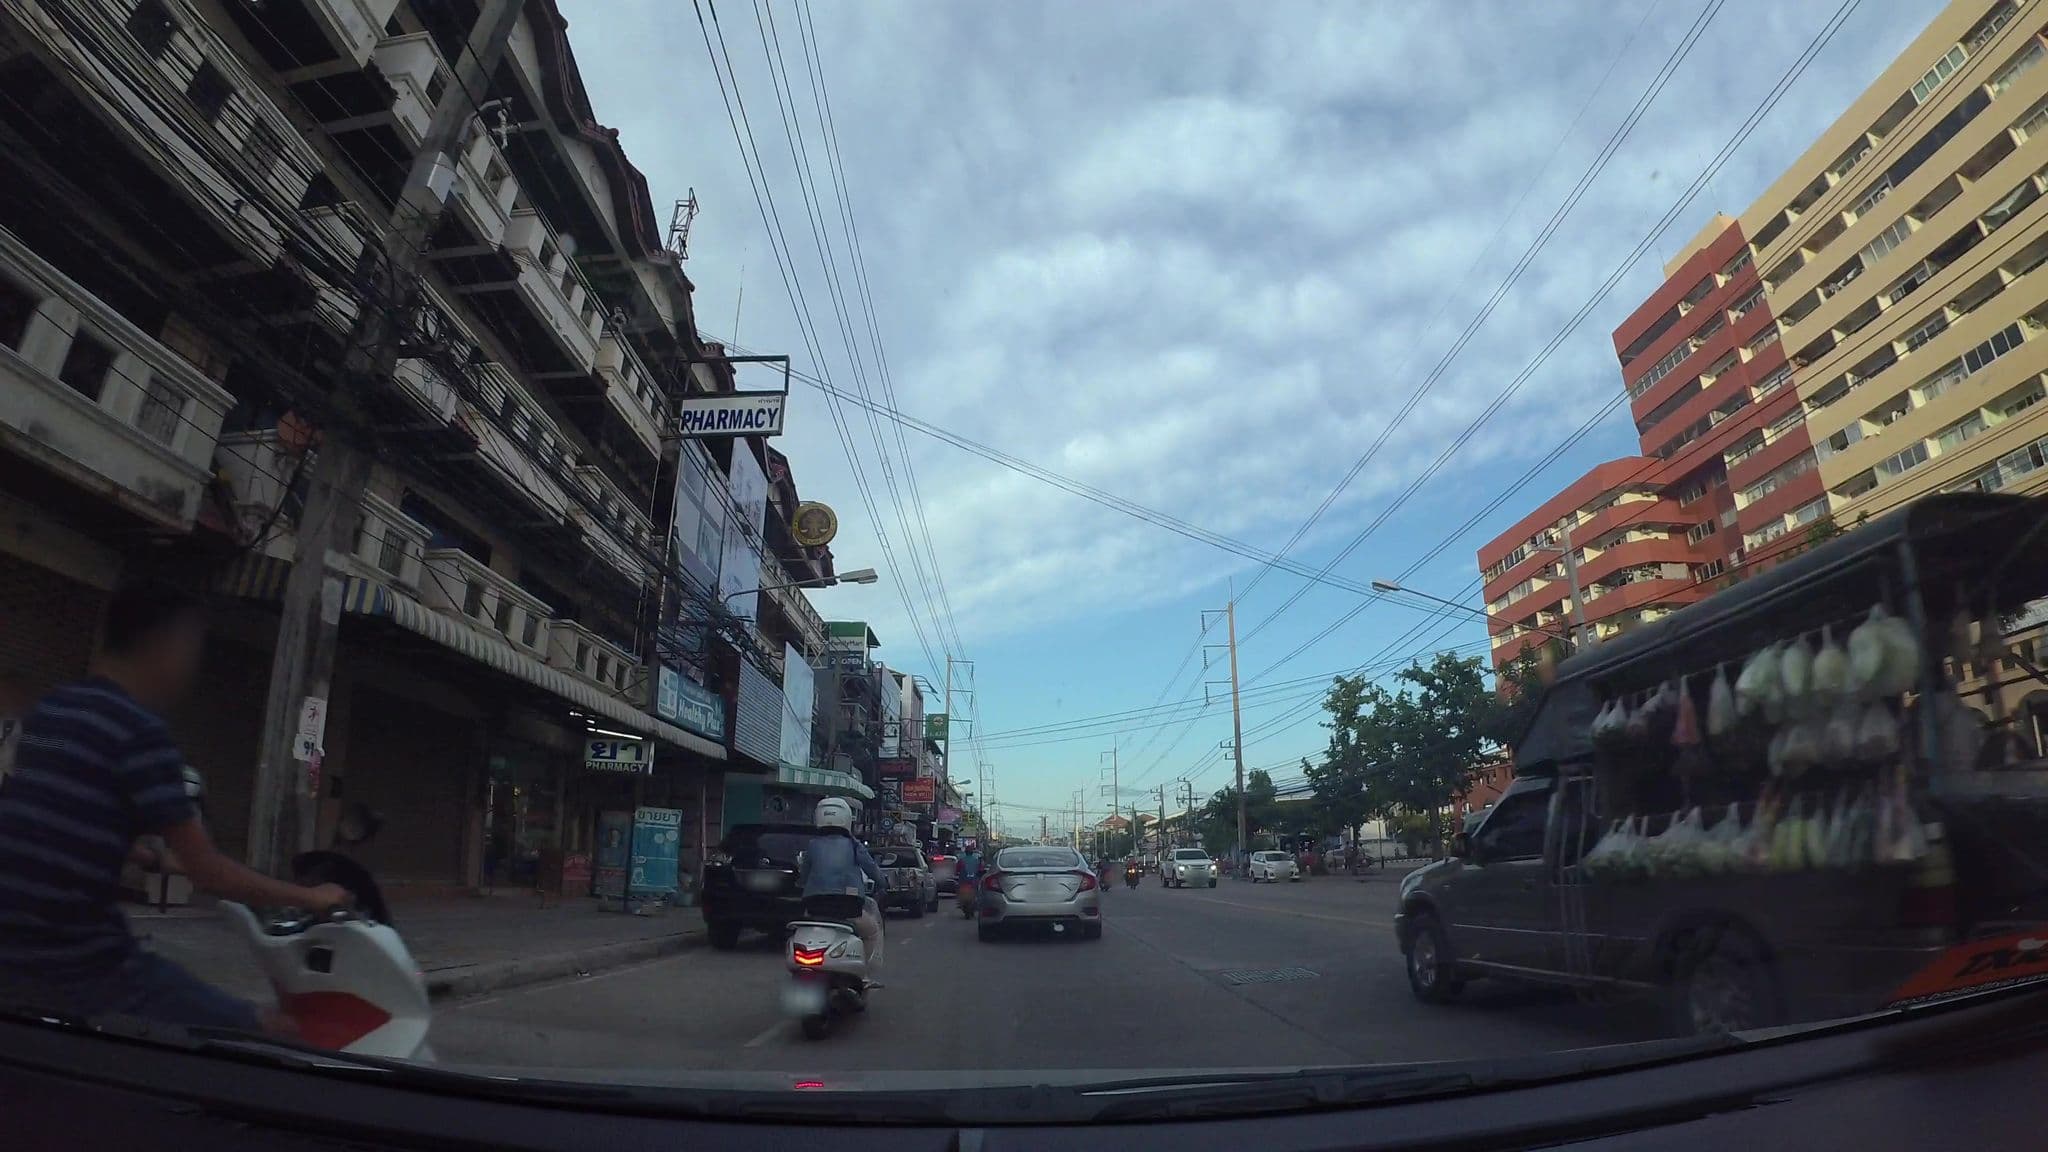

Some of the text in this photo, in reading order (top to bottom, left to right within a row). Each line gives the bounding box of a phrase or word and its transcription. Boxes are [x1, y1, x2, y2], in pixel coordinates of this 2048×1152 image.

[681, 407, 779, 430] PHARMACY
[591, 741, 642, 761] ยา
[585, 761, 645, 773] PHARMACY
[638, 809, 679, 823] ขายยา
